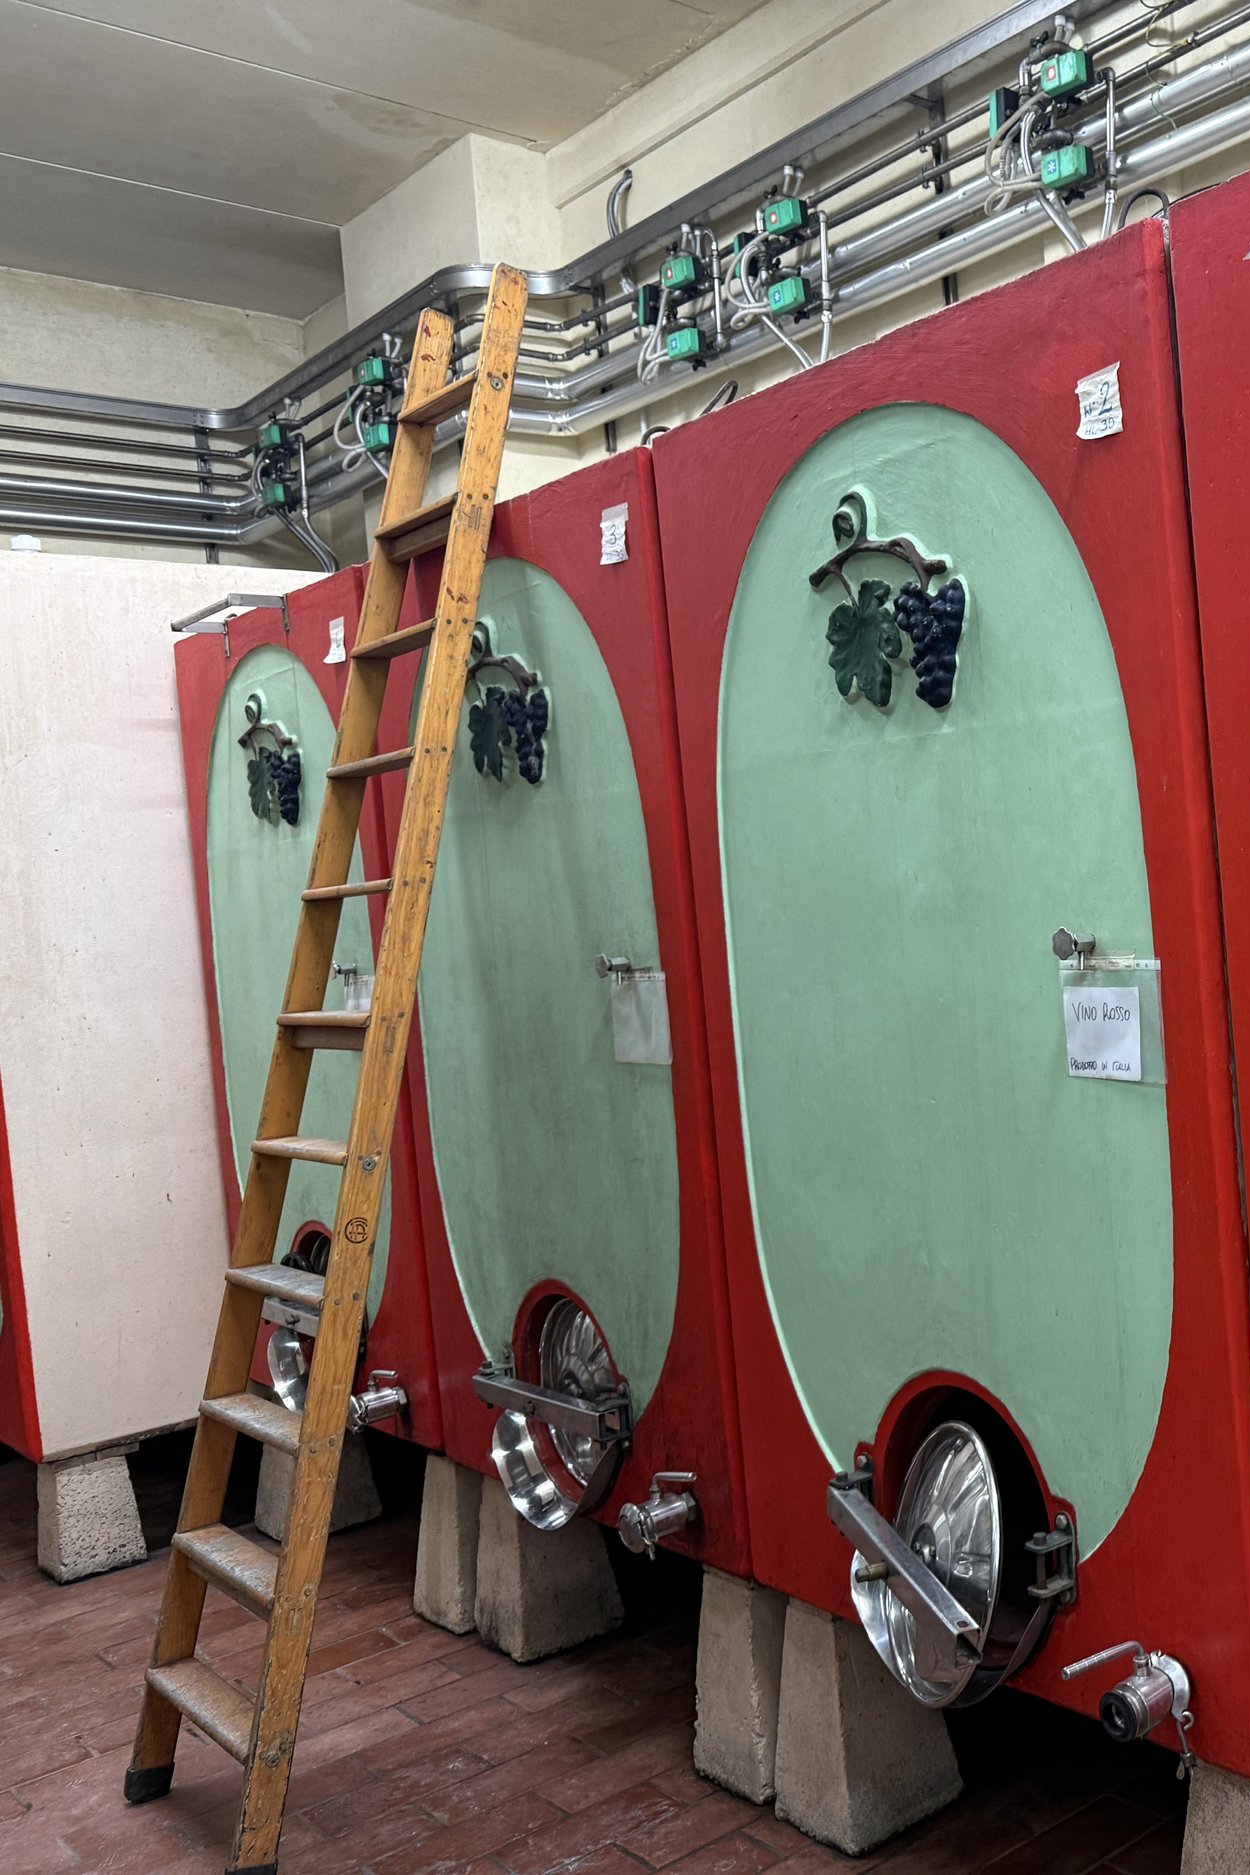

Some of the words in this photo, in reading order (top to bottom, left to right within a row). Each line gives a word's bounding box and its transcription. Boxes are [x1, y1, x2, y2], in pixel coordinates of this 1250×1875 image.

[1098, 381, 1113, 416] 2
[1071, 1001, 1098, 1022] VINO
[1102, 1002, 1131, 1021] ROSSO
[1070, 1057, 1098, 1071] PRODOTTO
[1101, 1061, 1108, 1071] IN
